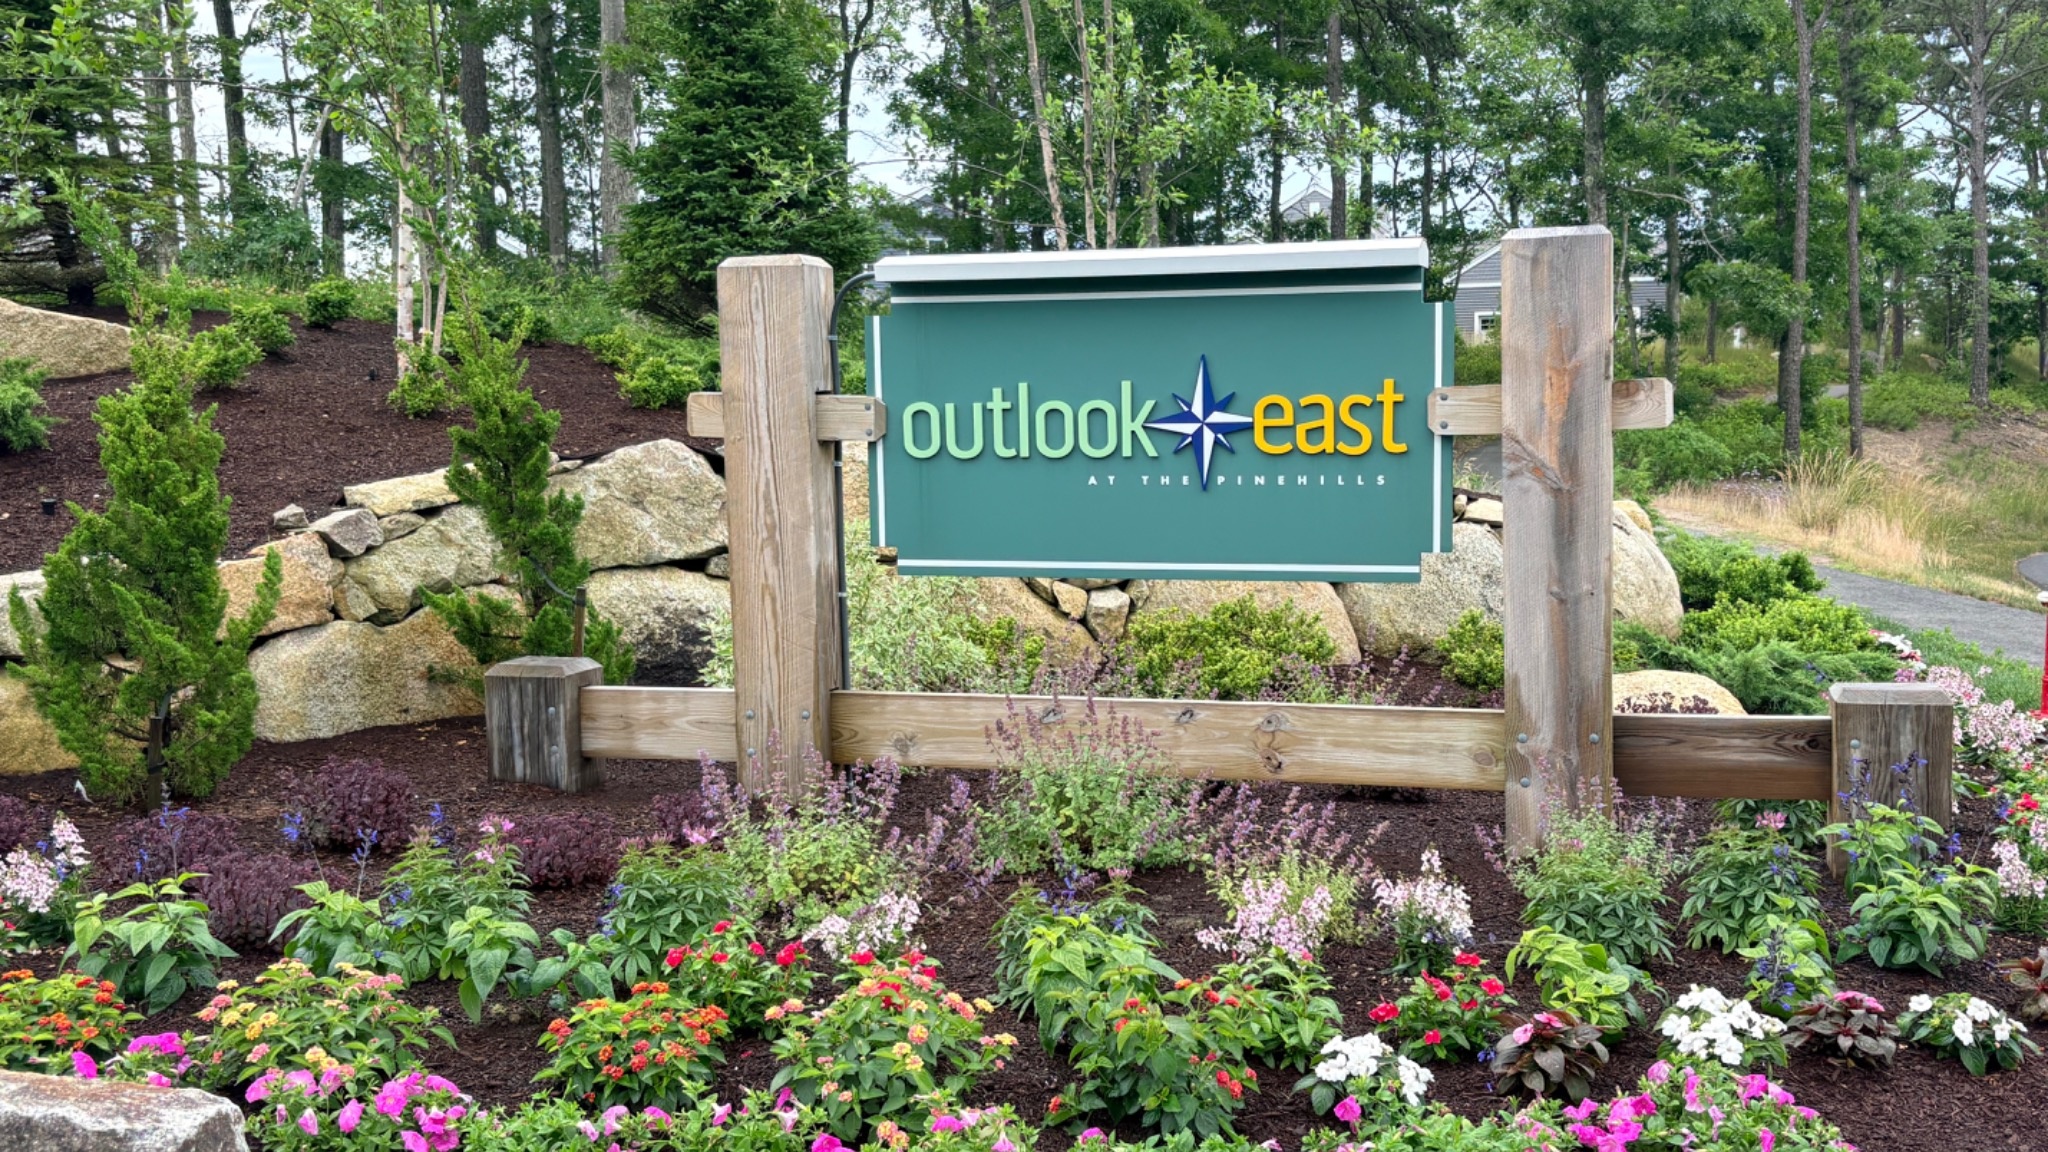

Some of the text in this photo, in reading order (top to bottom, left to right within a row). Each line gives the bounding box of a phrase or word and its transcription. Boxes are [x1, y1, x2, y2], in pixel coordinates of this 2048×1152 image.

[902, 378, 1408, 459] outlook east
[1087, 475, 1386, 486] AT THE PINEHILLS
